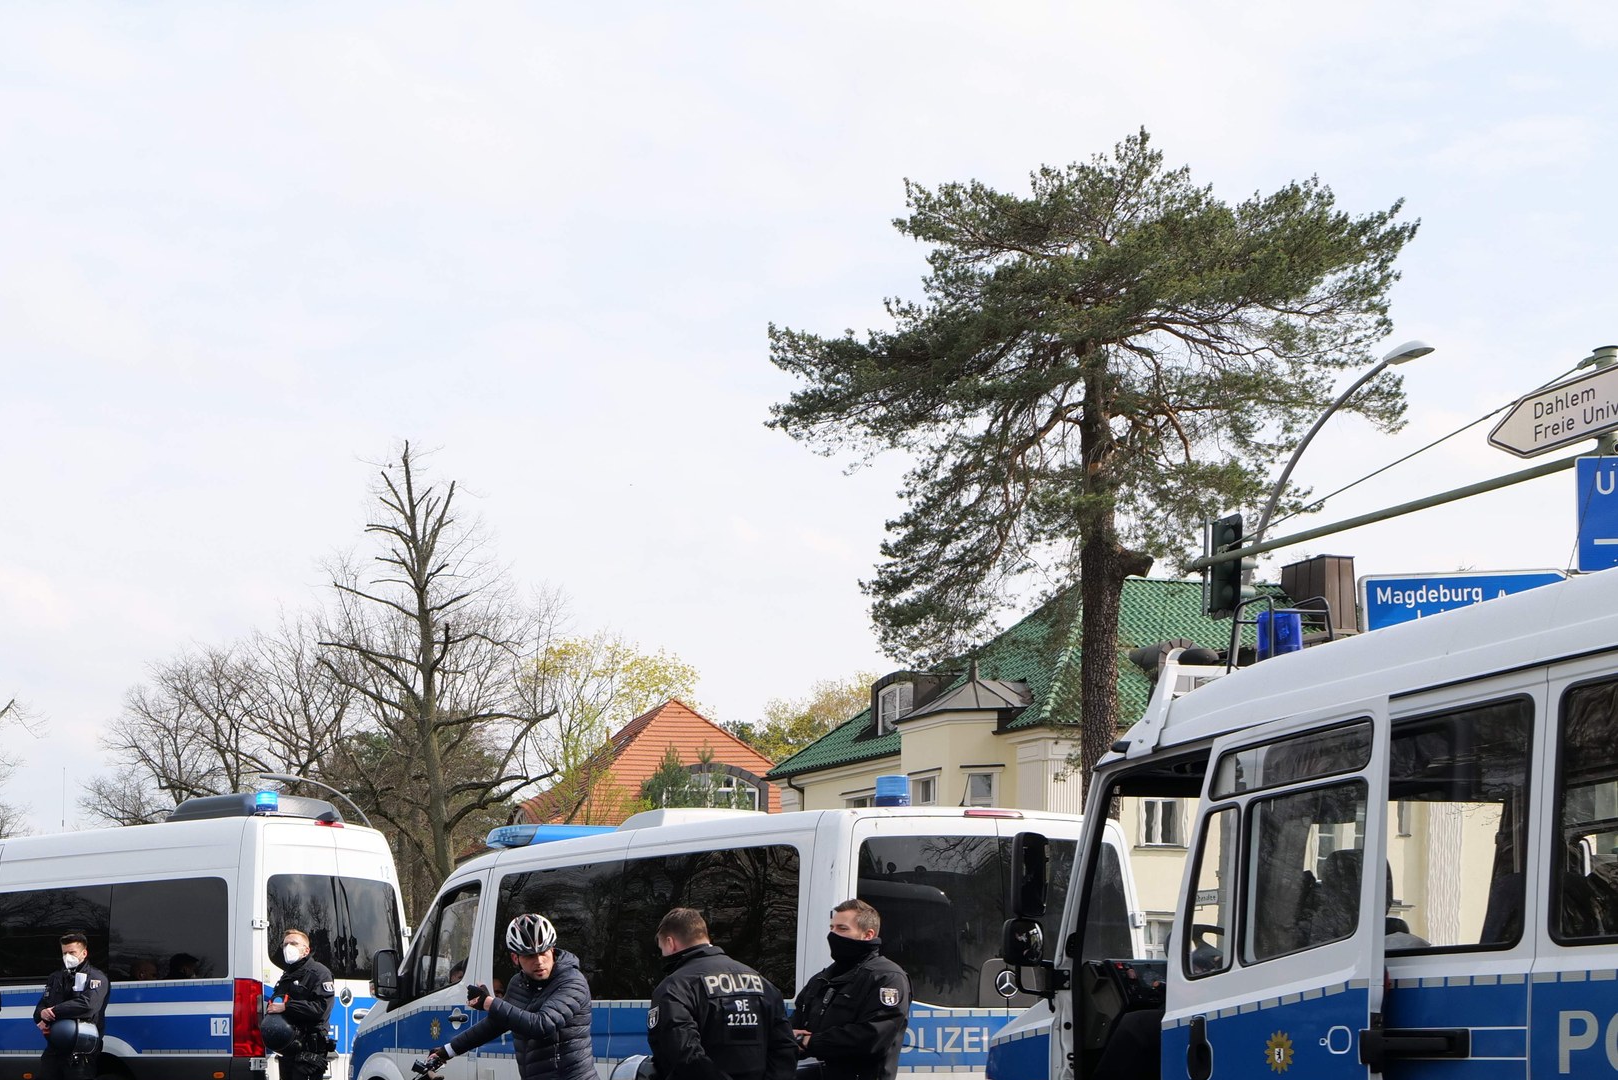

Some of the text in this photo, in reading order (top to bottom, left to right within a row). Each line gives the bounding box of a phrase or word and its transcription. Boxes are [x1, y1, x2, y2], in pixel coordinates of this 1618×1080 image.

[1534, 387, 1596, 420] Dahlem
[1534, 416, 1575, 442] Freie
[1376, 584, 1483, 608] Magdeburg
[704, 973, 764, 995] POLIZEI
[735, 999, 750, 1012] BE
[727, 1013, 759, 1026] 12112
[899, 1027, 989, 1053] OLIZEI
